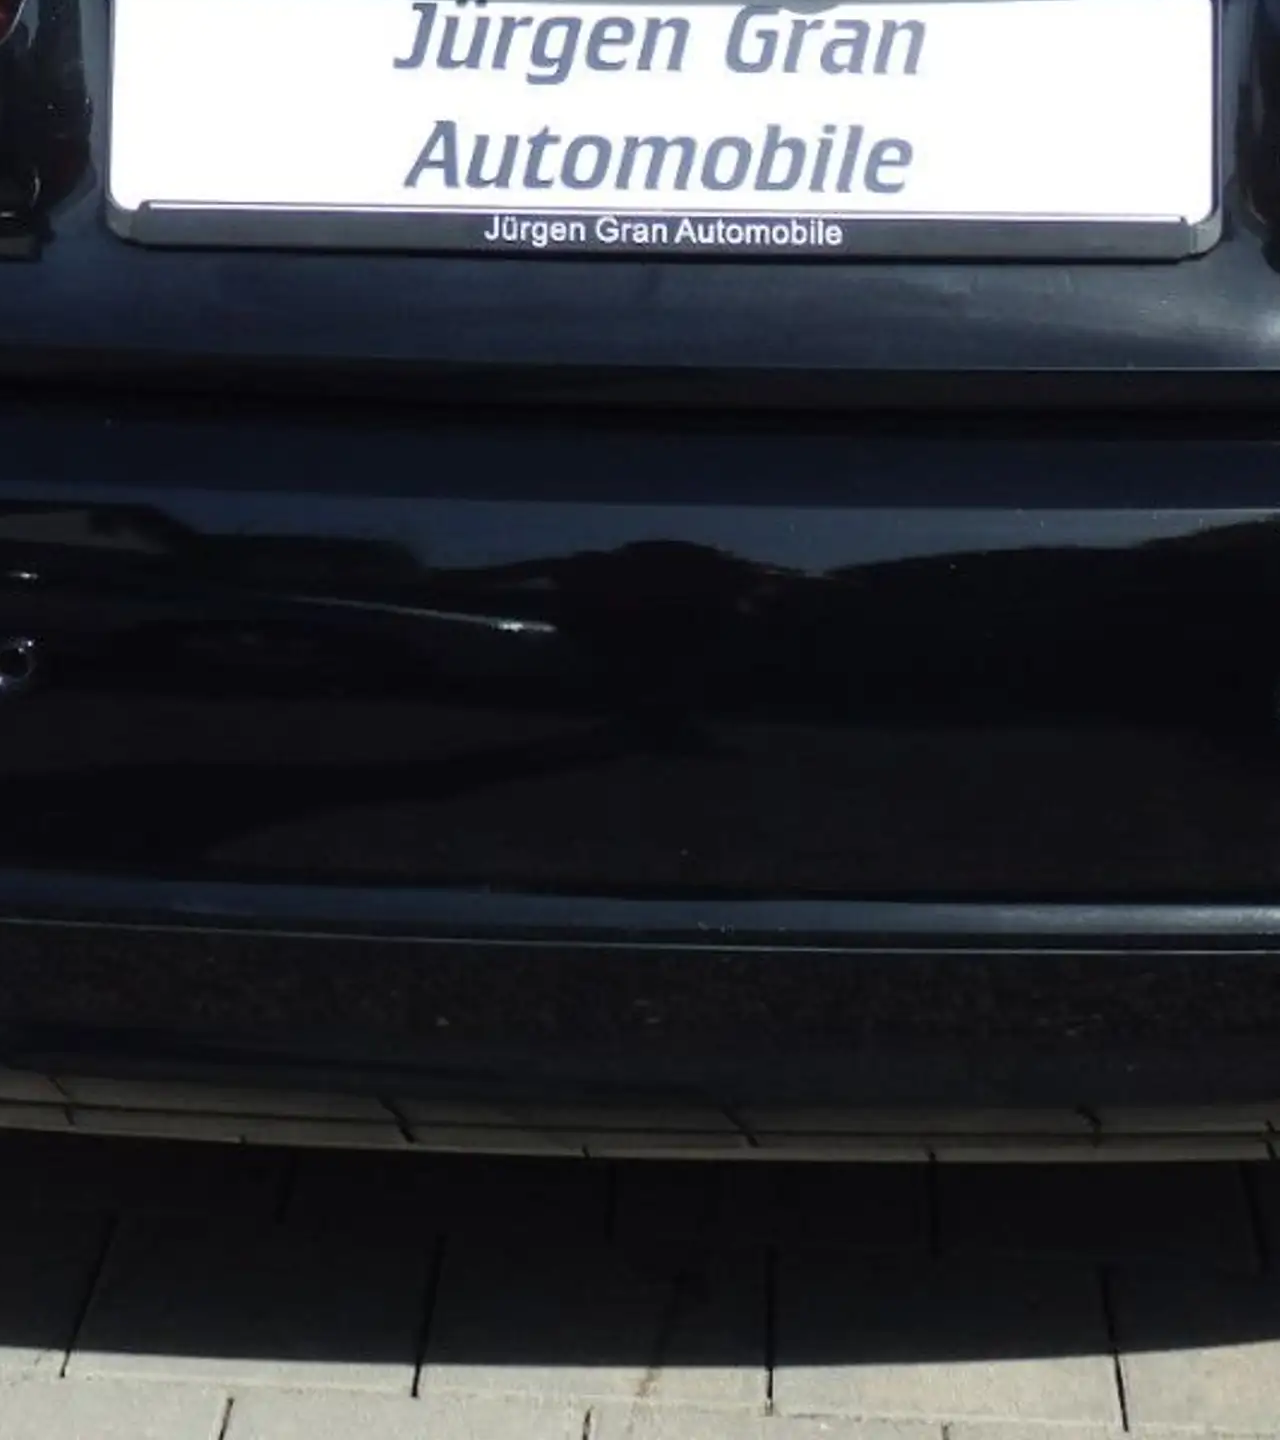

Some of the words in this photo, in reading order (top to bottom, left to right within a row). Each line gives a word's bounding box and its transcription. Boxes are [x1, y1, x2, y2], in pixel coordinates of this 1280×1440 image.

[725, 4, 926, 75] Gran
[404, 119, 914, 194] Automobile
[484, 216, 586, 247] Jürgen
[595, 216, 667, 243] Gran
[674, 218, 843, 245] Automobile
